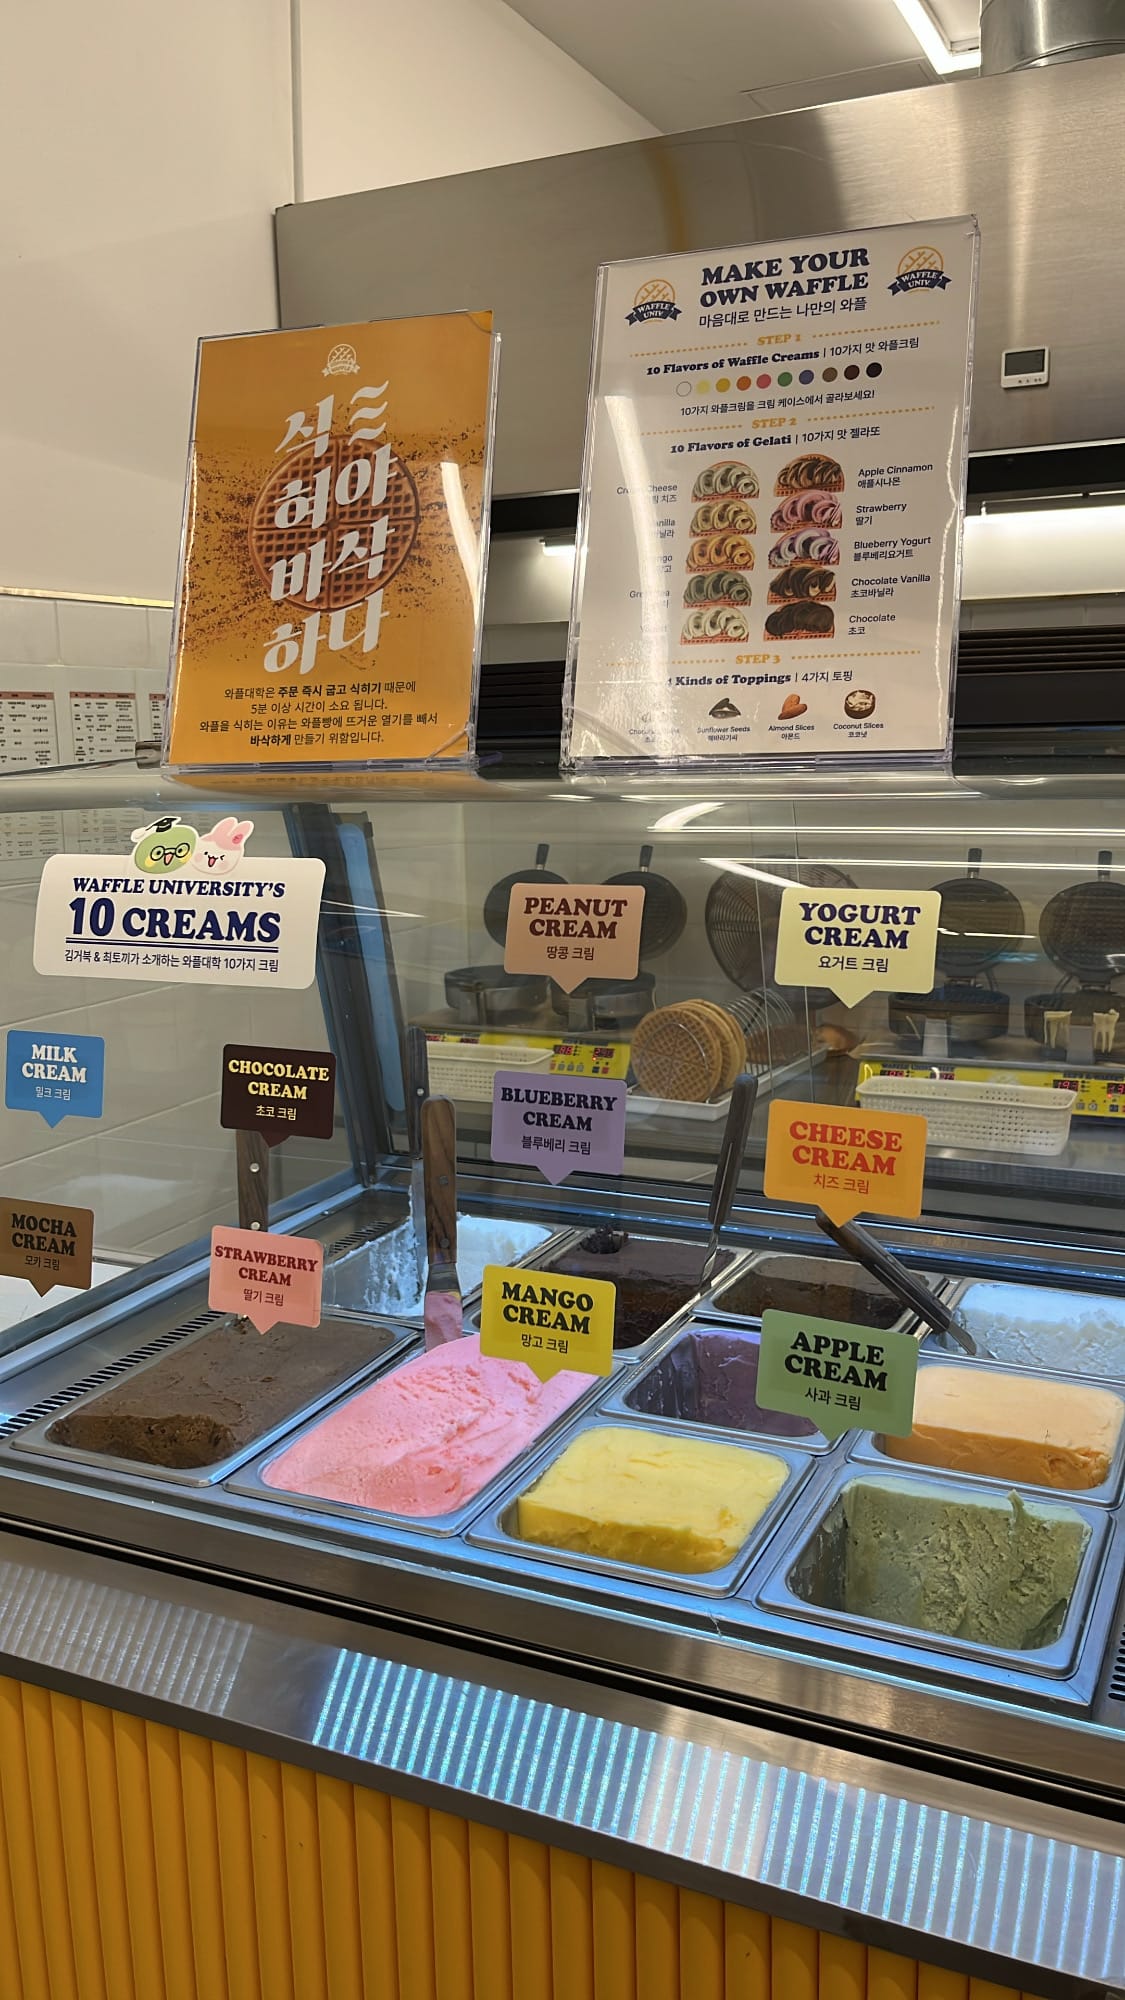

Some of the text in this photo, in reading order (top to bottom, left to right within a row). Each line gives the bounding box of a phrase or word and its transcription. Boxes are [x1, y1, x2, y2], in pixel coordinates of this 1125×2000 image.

[701, 248, 870, 286] MAKE YOUR
[901, 271, 938, 282] WAFFLE
[700, 271, 869, 308] OWN WAFFLE
[638, 303, 670, 313] WAFFLE
[699, 296, 867, 329] 마음대로 만드는 나만의 와플
[757, 334, 792, 347] STEP
[647, 337, 919, 376] 10 Flavors of Waffle Creams 10가지 맛 와플크림
[680, 390, 875, 416] 10가지 와플크림을 크림 케이스에서 골라보세요!
[752, 418, 786, 429] STEP
[670, 426, 881, 453] 10 Flavors of Gelati 10가지 맛 젤라또
[858, 464, 933, 478] Apple Cinnamon
[856, 504, 907, 514] Strawberry
[856, 516, 873, 526] 딸기
[854, 536, 932, 550] Blueberry Yogurt
[852, 574, 931, 586] Chocolate Vanilla
[849, 614, 896, 623] Chocolate
[736, 655, 781, 665] STEP 3
[675, 674, 712, 686] Kinds
[714, 674, 729, 685] of
[732, 673, 791, 687] Toppings
[802, 671, 829, 683] 4가지
[832, 670, 853, 682] 토핑
[224, 681, 416, 700] 와플대학은 주문 즉시 굽고 식히기 때문에
[251, 699, 388, 715] 5분 이상 시간이 소요 됩니다.
[199, 712, 438, 732] 와플을 식히는 이유는 와플빵에 뜨거운 열기를 빼서
[250, 731, 384, 747] 바삭하게 만들기 위함입니다.
[73, 878, 145, 894] WAFFLE
[524, 896, 628, 918] PEANUT
[800, 902, 921, 927] YOGURT
[69, 897, 281, 943] 10 CREAMS
[529, 918, 618, 940] CREAM
[804, 926, 910, 950] CREAM
[64, 950, 279, 973] 김거북 & 최토끼가 소개하는 와플대학 10가지 크림
[546, 945, 596, 962] 땅콩 크림
[818, 956, 890, 973] 요거트 크림
[32, 1044, 78, 1064] MILK
[21, 1062, 87, 1084] CREAM
[228, 1059, 330, 1082] CHOCOLATE
[36, 1086, 72, 1101] 밀크 크림
[248, 1082, 309, 1100] CREAM
[501, 1087, 618, 1112] BLUEBERRY
[256, 1104, 298, 1121] 초코 크림
[522, 1112, 593, 1132] CREAM
[521, 1134, 592, 1156] 블루베리 크림
[790, 1120, 903, 1153] CHEESE
[792, 1146, 896, 1177] CREAM
[814, 1172, 870, 1195] 치즈 크림
[12, 1213, 78, 1238] MOCHA
[11, 1234, 76, 1257] CREAM
[24, 1255, 61, 1271] 모카 크림
[214, 1244, 319, 1273] STRAWBERRY
[238, 1267, 292, 1287] CREAM
[243, 1288, 285, 1307] 딸기 크림
[501, 1282, 594, 1312] MANGO
[502, 1305, 591, 1336] CREAM
[521, 1332, 569, 1355] 망고 크림
[790, 1331, 885, 1367] APPLE
[784, 1355, 888, 1392] CREAM
[805, 1386, 861, 1411] 사과 크림
